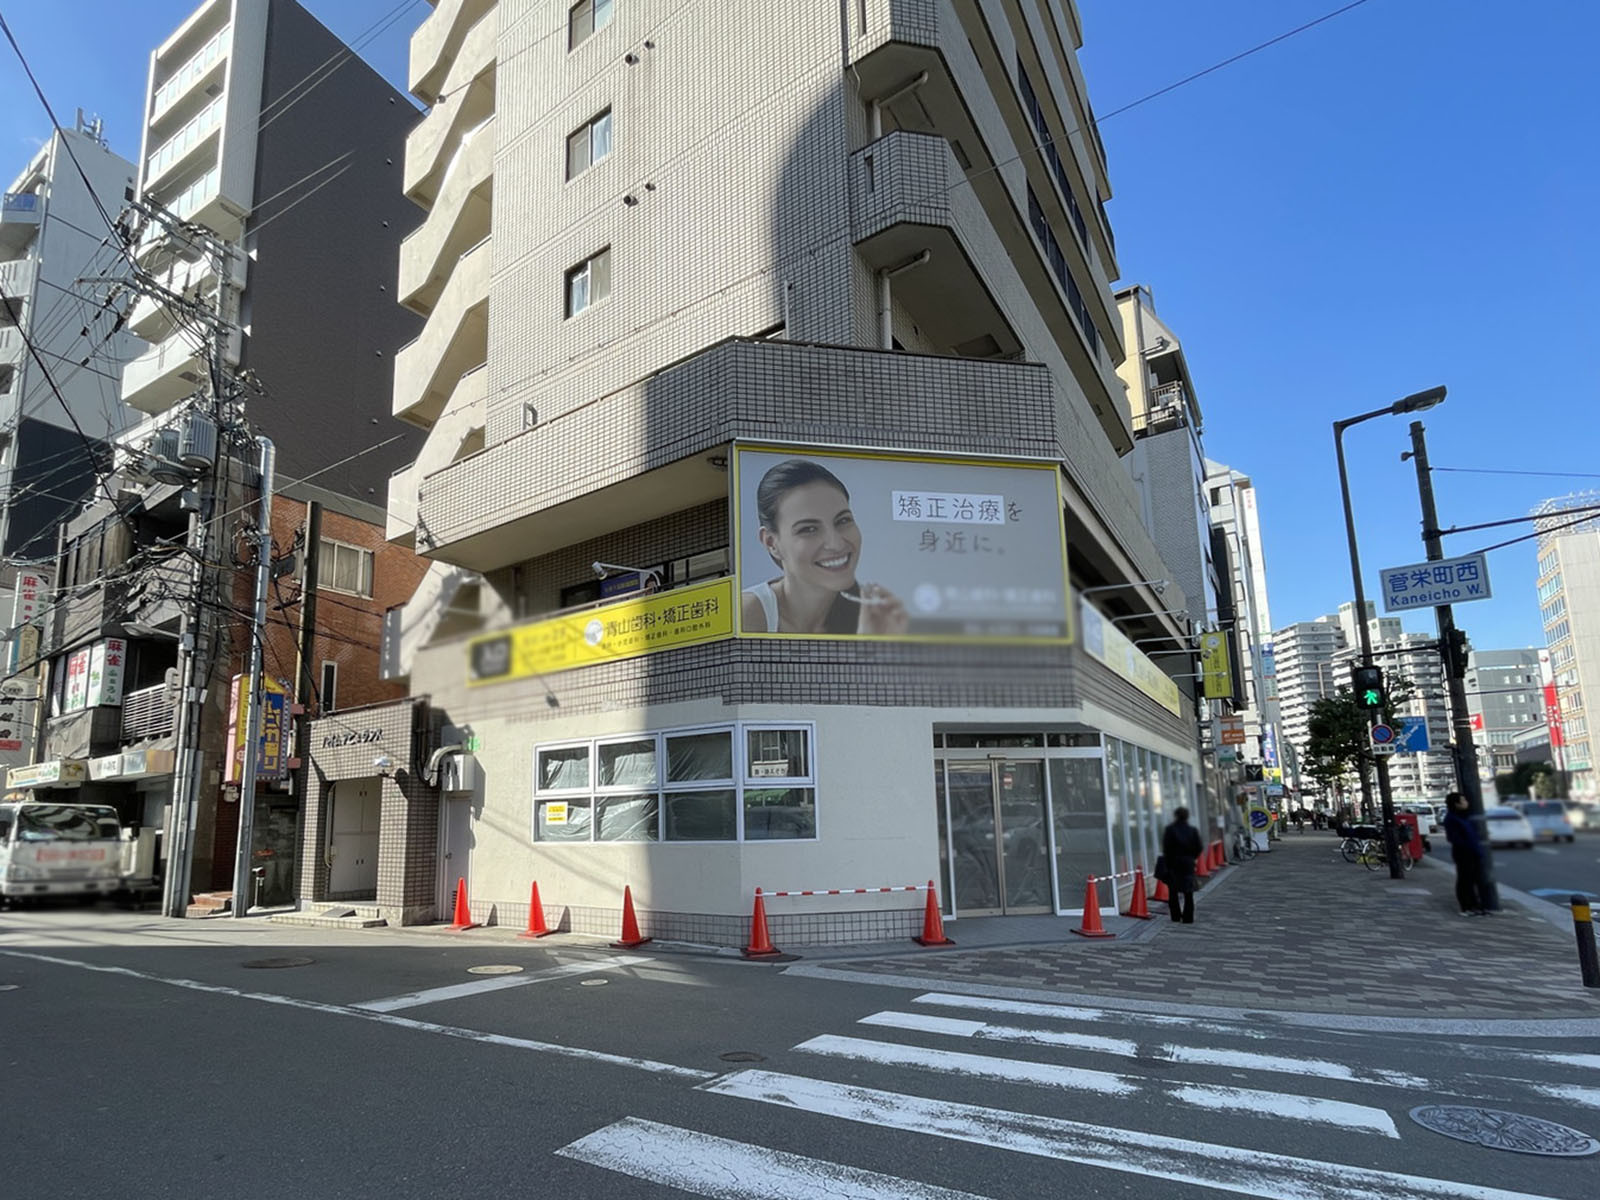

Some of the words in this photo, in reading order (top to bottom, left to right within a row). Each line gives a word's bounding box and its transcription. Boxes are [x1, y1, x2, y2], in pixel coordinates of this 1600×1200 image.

[898, 495, 1023, 522] 矯正治療を
[919, 529, 1006, 555] 身近に。
[1388, 561, 1478, 592] 菅栄町西
[1391, 588, 1461, 606] Kaneicho
[1466, 583, 1483, 595] W.
[107, 639, 123, 667] 麻雀
